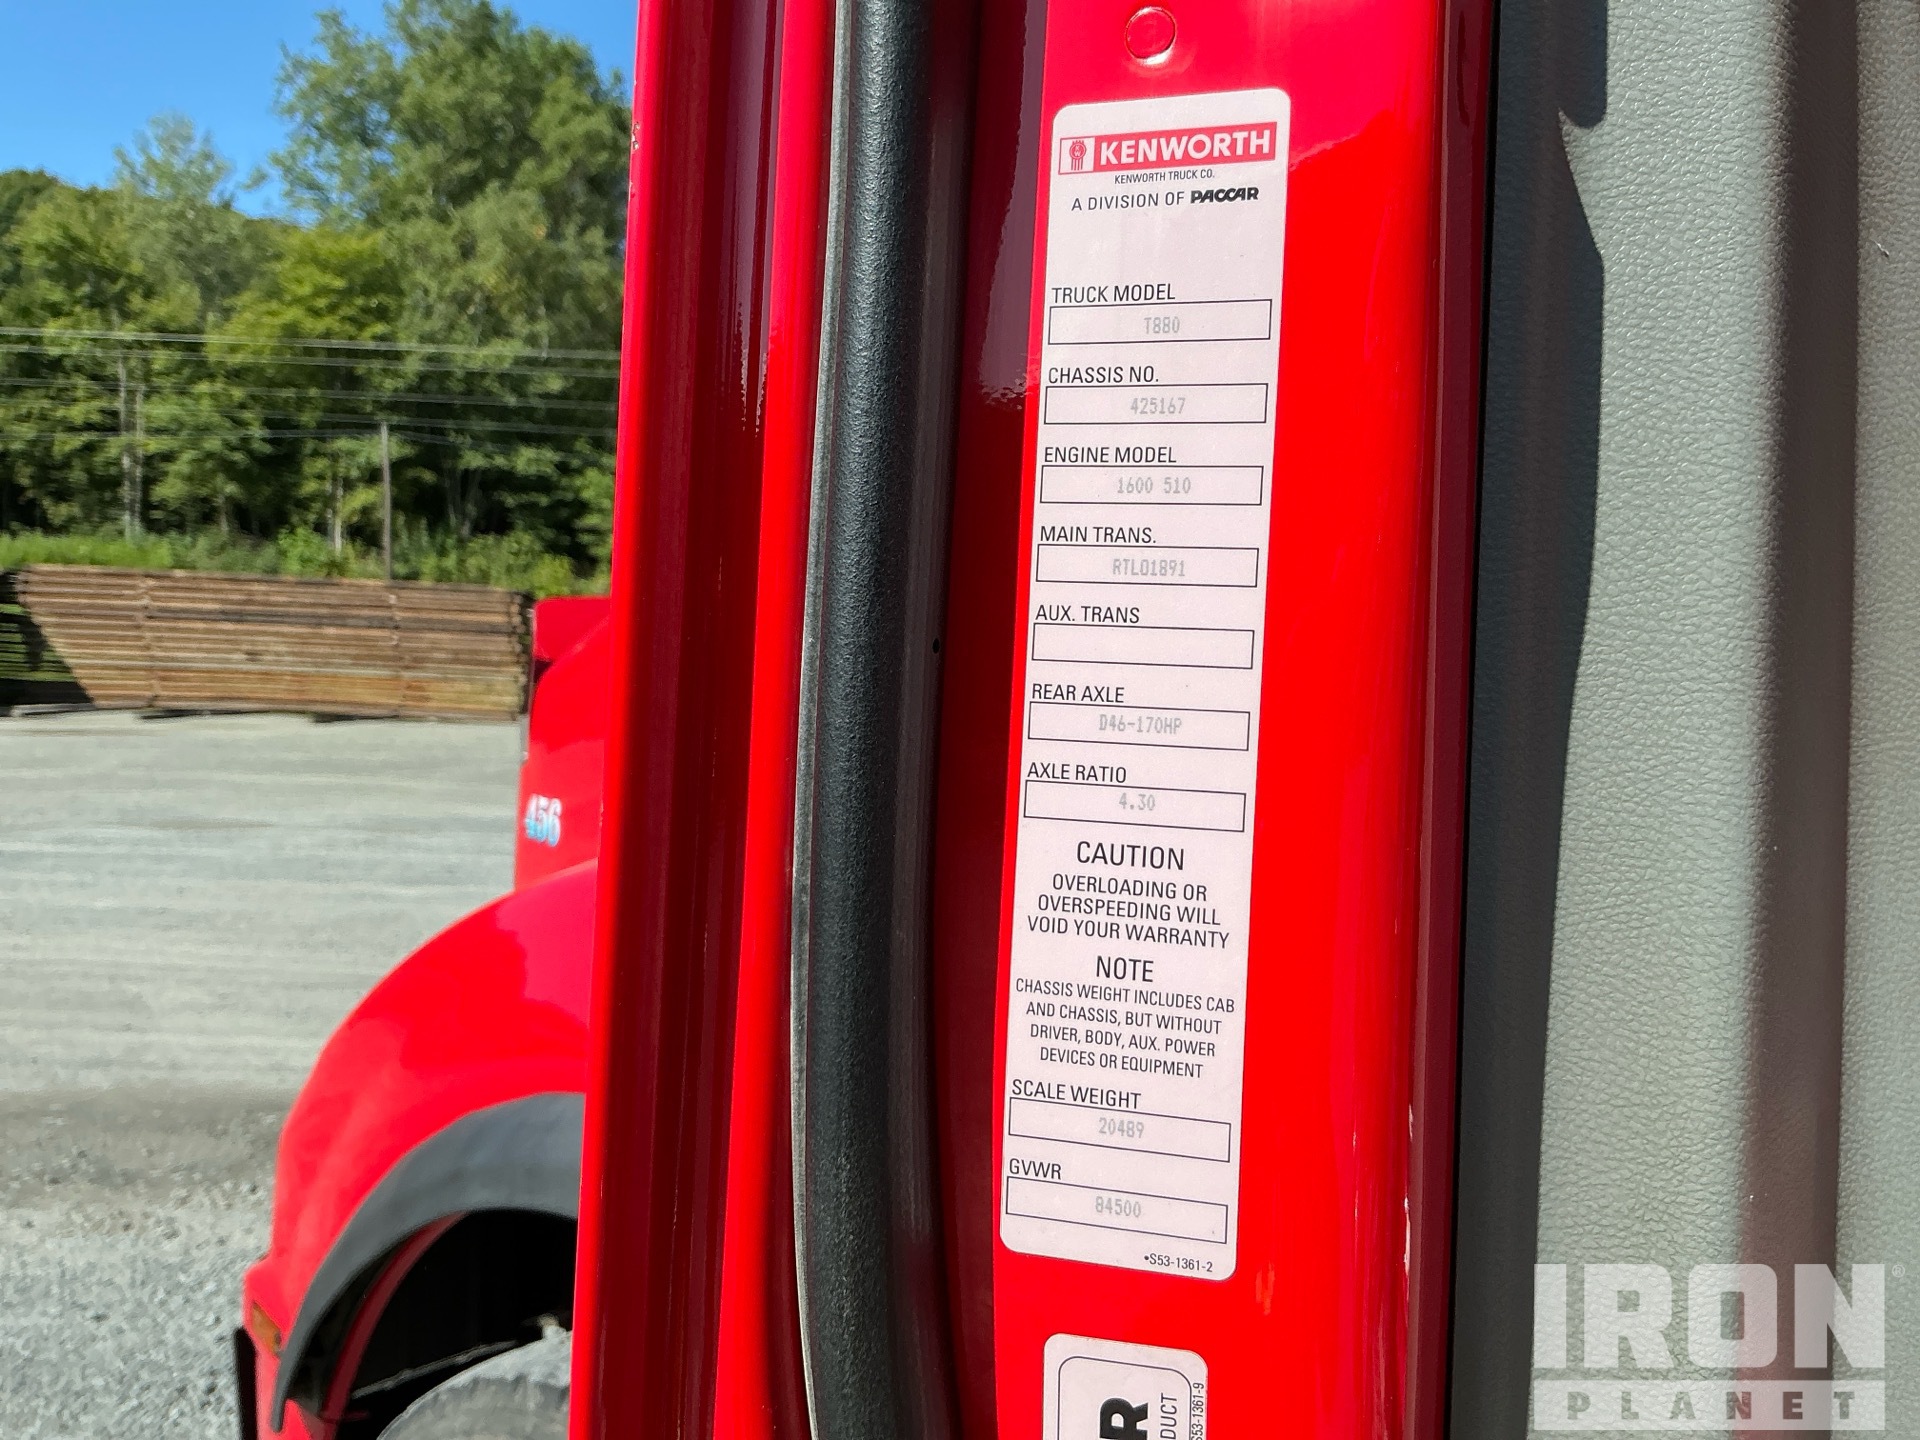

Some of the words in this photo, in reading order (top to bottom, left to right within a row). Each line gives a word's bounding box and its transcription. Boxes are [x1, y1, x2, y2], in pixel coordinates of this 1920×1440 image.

[1100, 129, 1271, 165] KENWORTH
[1114, 171, 1166, 184] KENWORTH
[1168, 169, 1198, 181] TRUCK
[1200, 168, 1215, 179] CO.
[1071, 198, 1082, 211] A
[1088, 193, 1159, 211] DIVISION
[1165, 191, 1185, 206] OF
[1190, 187, 1259, 204] PACCAR
[1052, 285, 1109, 304] TRUCK
[1113, 283, 1176, 302] MODEL
[1144, 316, 1180, 334] T880
[1048, 366, 1124, 384] CHASSIS
[1129, 365, 1159, 383] NO.
[1130, 397, 1186, 415] 425167
[1044, 446, 1110, 463] ENGINE
[1115, 446, 1177, 463] MODEL
[1117, 477, 1153, 494] 1600
[1163, 477, 1192, 494] 510
[1040, 525, 1088, 542] MAIN
[1093, 526, 1157, 544] TRANS.
[1035, 604, 1075, 622] AUX.
[1081, 606, 1140, 624] TRANS
[1032, 683, 1076, 701] REAR
[1081, 685, 1125, 703] AXLE
[1099, 713, 1182, 735] D46-170HP
[1027, 762, 1070, 780] AXLE
[1075, 765, 1127, 783] RATIO
[1118, 792, 1156, 811] 4.30
[525, 794, 562, 847] 456
[1076, 841, 1185, 870] CAUTION
[1052, 873, 1177, 899] OVERLOADING
[1183, 884, 1208, 902] OR
[1038, 894, 1171, 921] OVERSPEEDING
[1177, 905, 1221, 925] WILL
[1027, 915, 1068, 934] VOID
[1074, 919, 1120, 939] YOUR
[1125, 923, 1230, 949] WARRANTY
[1096, 955, 1154, 982] NOTE
[1015, 978, 1073, 997] CHASSIS
[1077, 983, 1131, 1003] WEIGHT
[1134, 989, 1202, 1010] INCLUDES
[1206, 996, 1235, 1013] CAB
[1026, 1002, 1055, 1017] AND
[1059, 1004, 1121, 1026] CHASSIS,
[1125, 1011, 1153, 1028] BUT
[1155, 1014, 1222, 1035] WITHOUT
[1030, 1023, 1081, 1044] DRIVER,
[1085, 1029, 1125, 1049] BODY,
[1129, 1034, 1160, 1052] AUX.
[1165, 1038, 1216, 1057] POWER
[1040, 1047, 1095, 1067] DEVICES
[1099, 1053, 1118, 1069] OR
[1121, 1056, 1203, 1078] EQUIPMENT
[1012, 1078, 1066, 1100] SCALE
[1070, 1085, 1141, 1109] WEIGHT
[1098, 1117, 1145, 1139] 20489
[1009, 1158, 1062, 1180] GVWR
[1095, 1196, 1142, 1218] 84500
